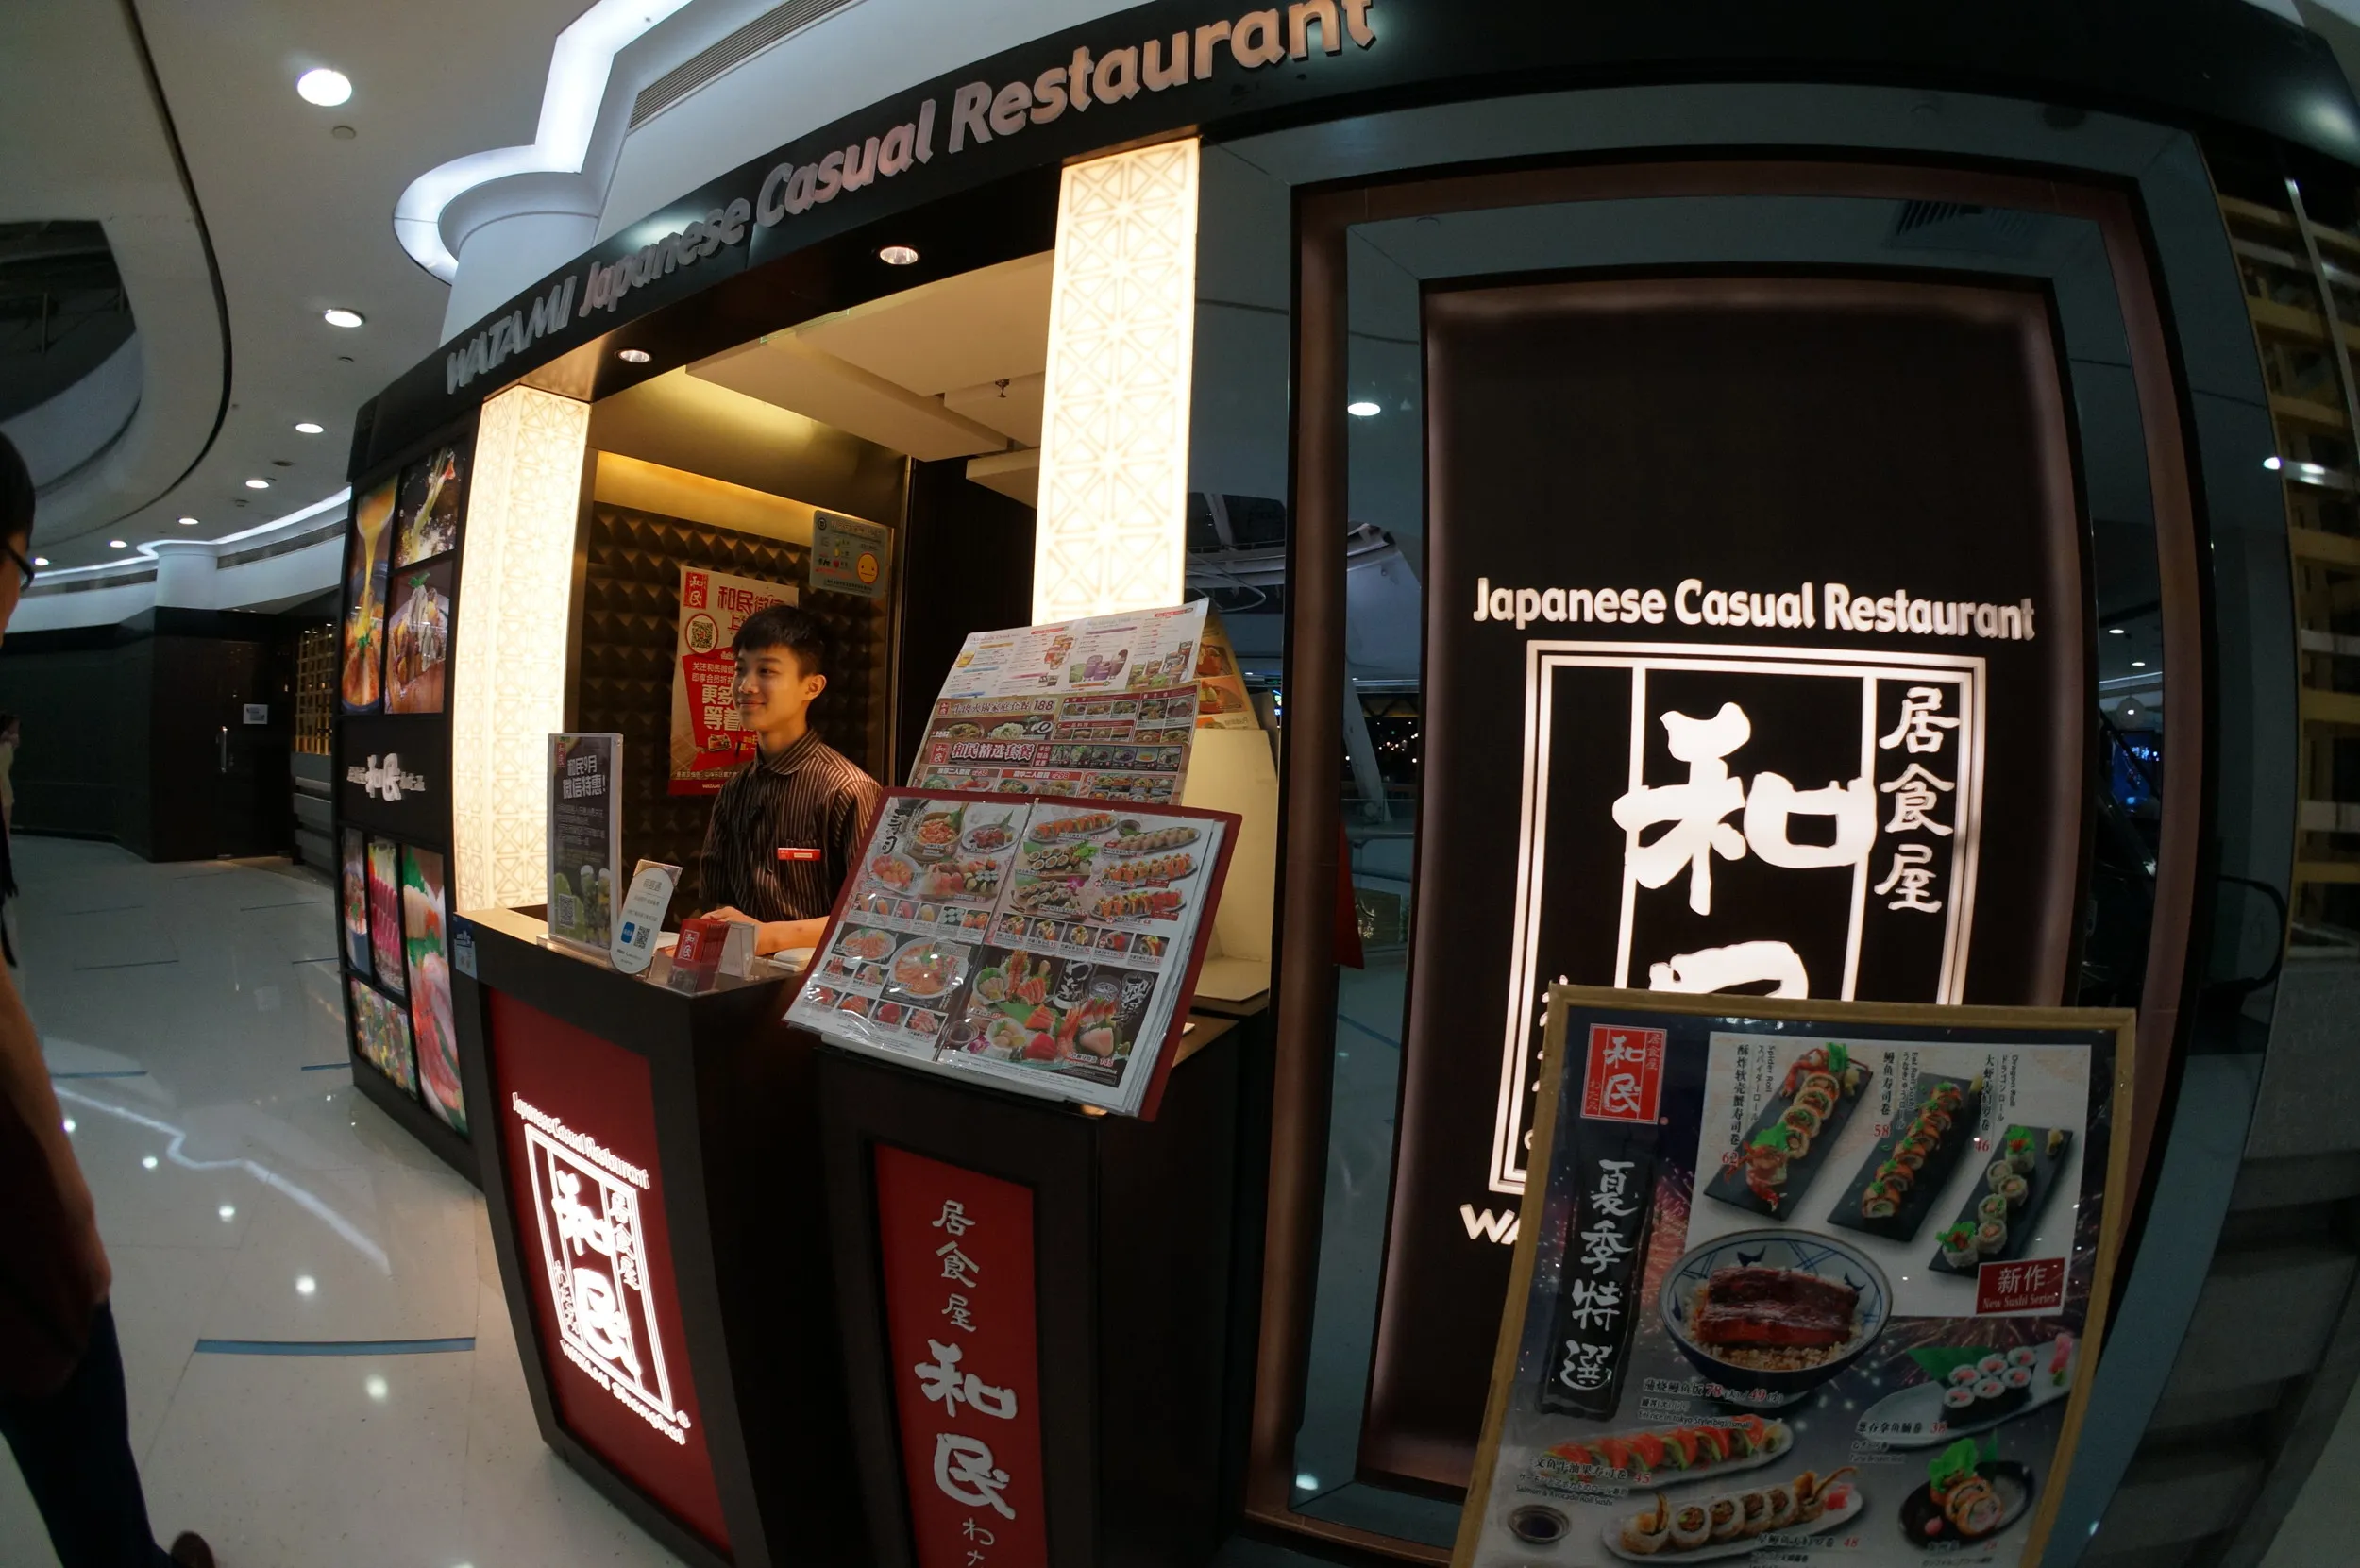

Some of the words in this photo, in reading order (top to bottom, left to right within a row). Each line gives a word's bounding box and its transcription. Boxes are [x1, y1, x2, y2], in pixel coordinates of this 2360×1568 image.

[447, 276, 578, 395] WATAMI
[579, 197, 751, 317] Japanese
[755, 98, 937, 228] Casual
[948, 0, 1376, 155] Restaurant
[1473, 577, 1666, 630] Japanese
[1674, 578, 1816, 630] Casual
[1823, 582, 2035, 641] Restaurant
[1033, 700, 1054, 711] 188
[1875, 686, 1961, 913] 居食屋
[1603, 1035, 1646, 1113] 和民
[931, 1199, 980, 1332] 居食屋
[1997, 1264, 2048, 1295] 新作
[2004, 1295, 2028, 1307] Sushi
[914, 1339, 1018, 1520] 和民
